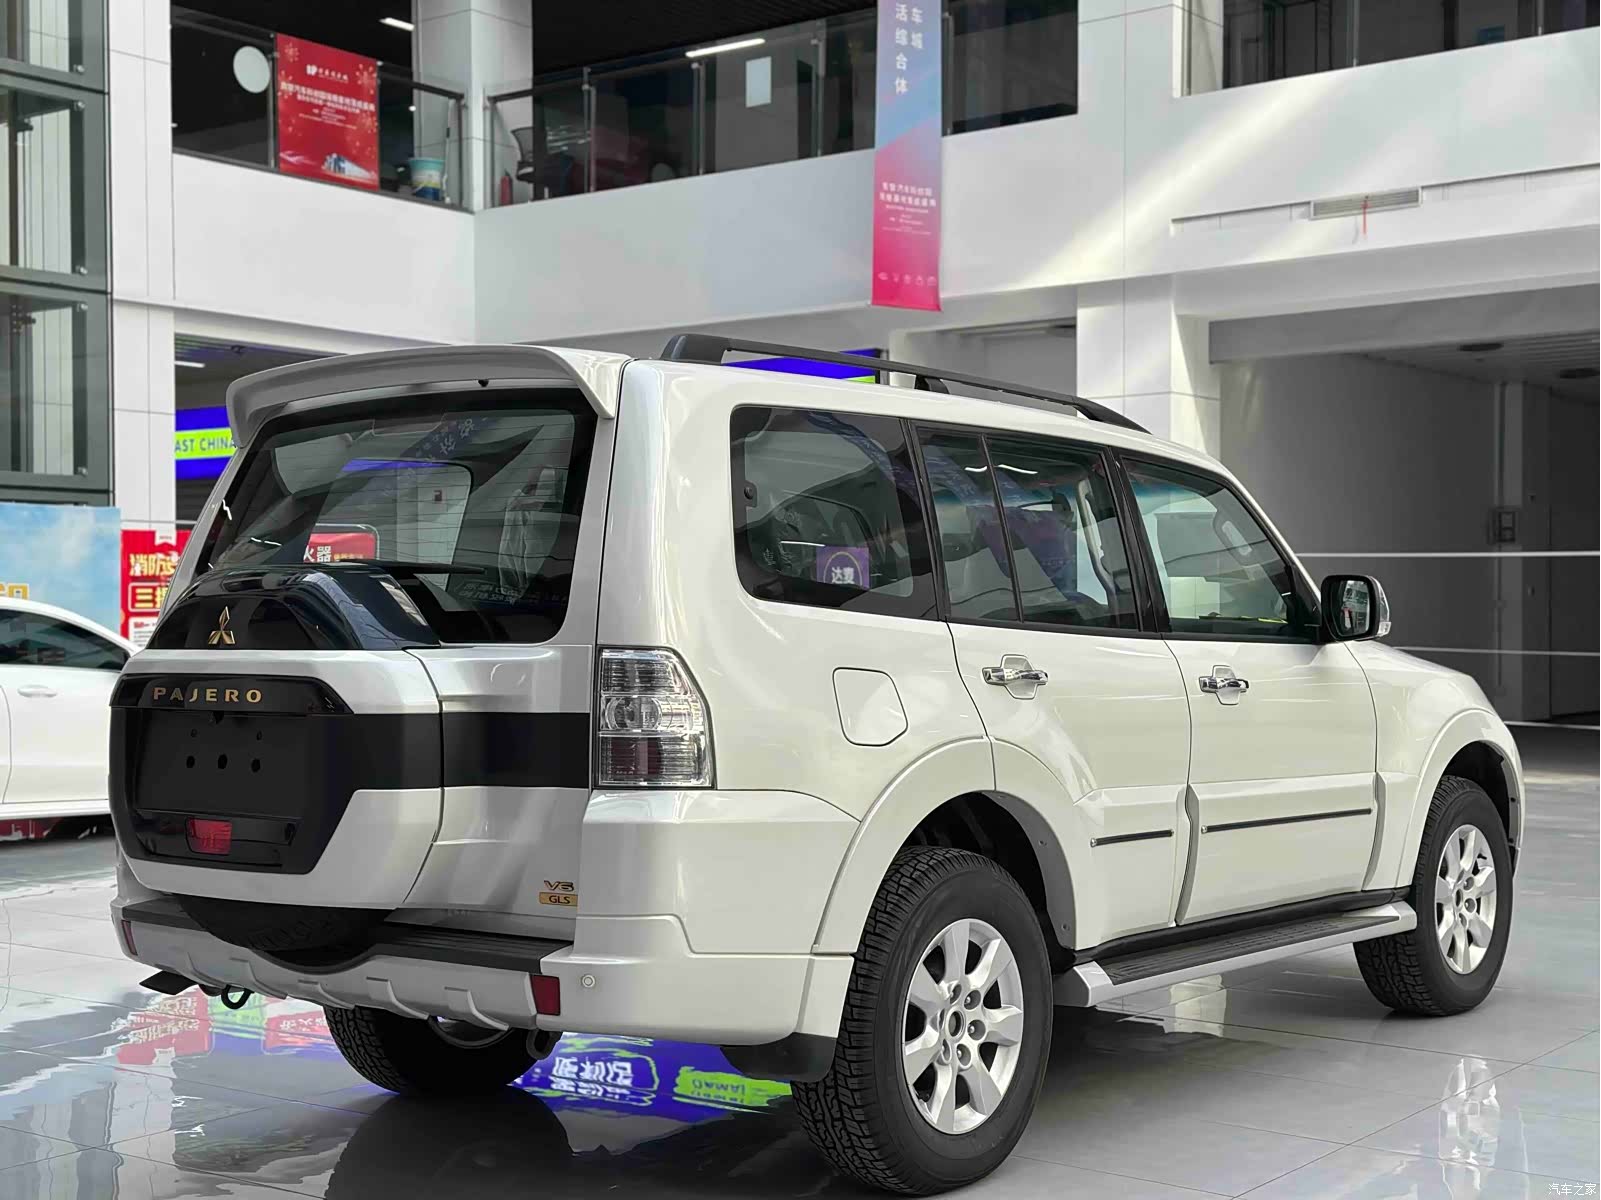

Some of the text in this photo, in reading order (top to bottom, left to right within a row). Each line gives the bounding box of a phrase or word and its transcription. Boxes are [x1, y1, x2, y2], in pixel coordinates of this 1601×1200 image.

[152, 687, 262, 703] PAJERO
[543, 880, 575, 892] V6
[548, 895, 571, 905] GLS
